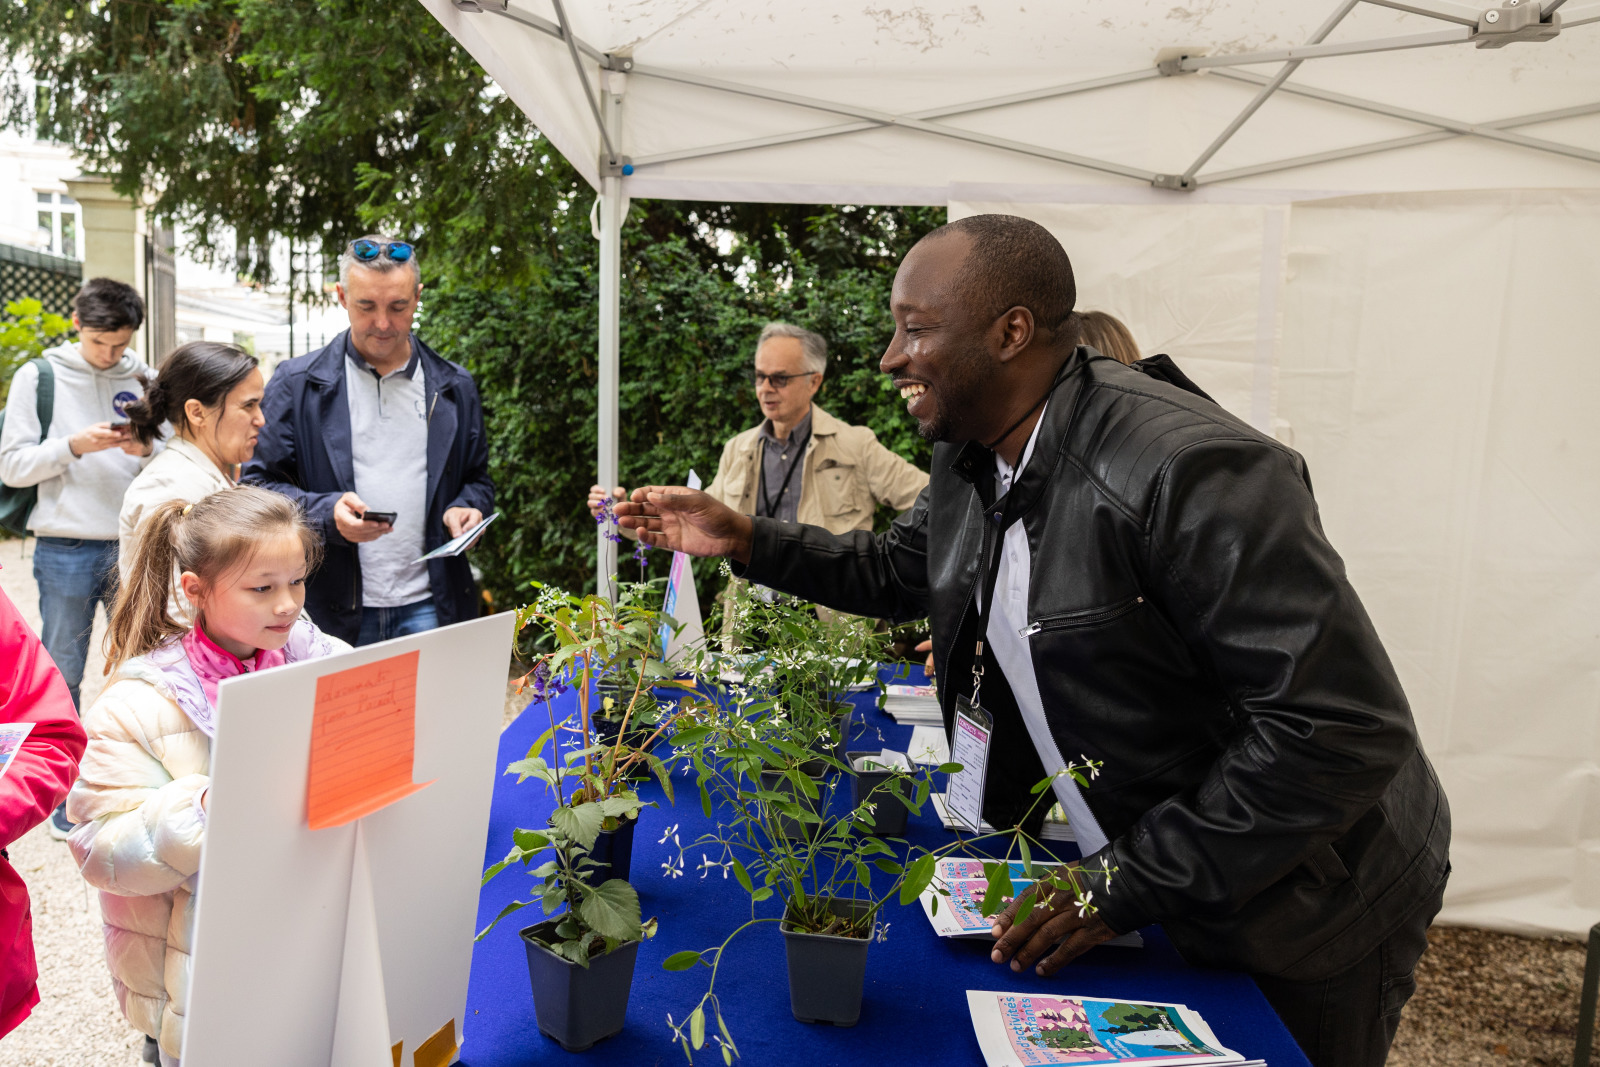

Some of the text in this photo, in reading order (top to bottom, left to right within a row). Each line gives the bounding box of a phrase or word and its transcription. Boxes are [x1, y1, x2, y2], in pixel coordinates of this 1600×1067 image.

[959, 881, 977, 908] enfants
[1003, 996, 1031, 1048] d'activités
[1021, 998, 1043, 1039] enfants
[1035, 1040, 1049, 1051] les
